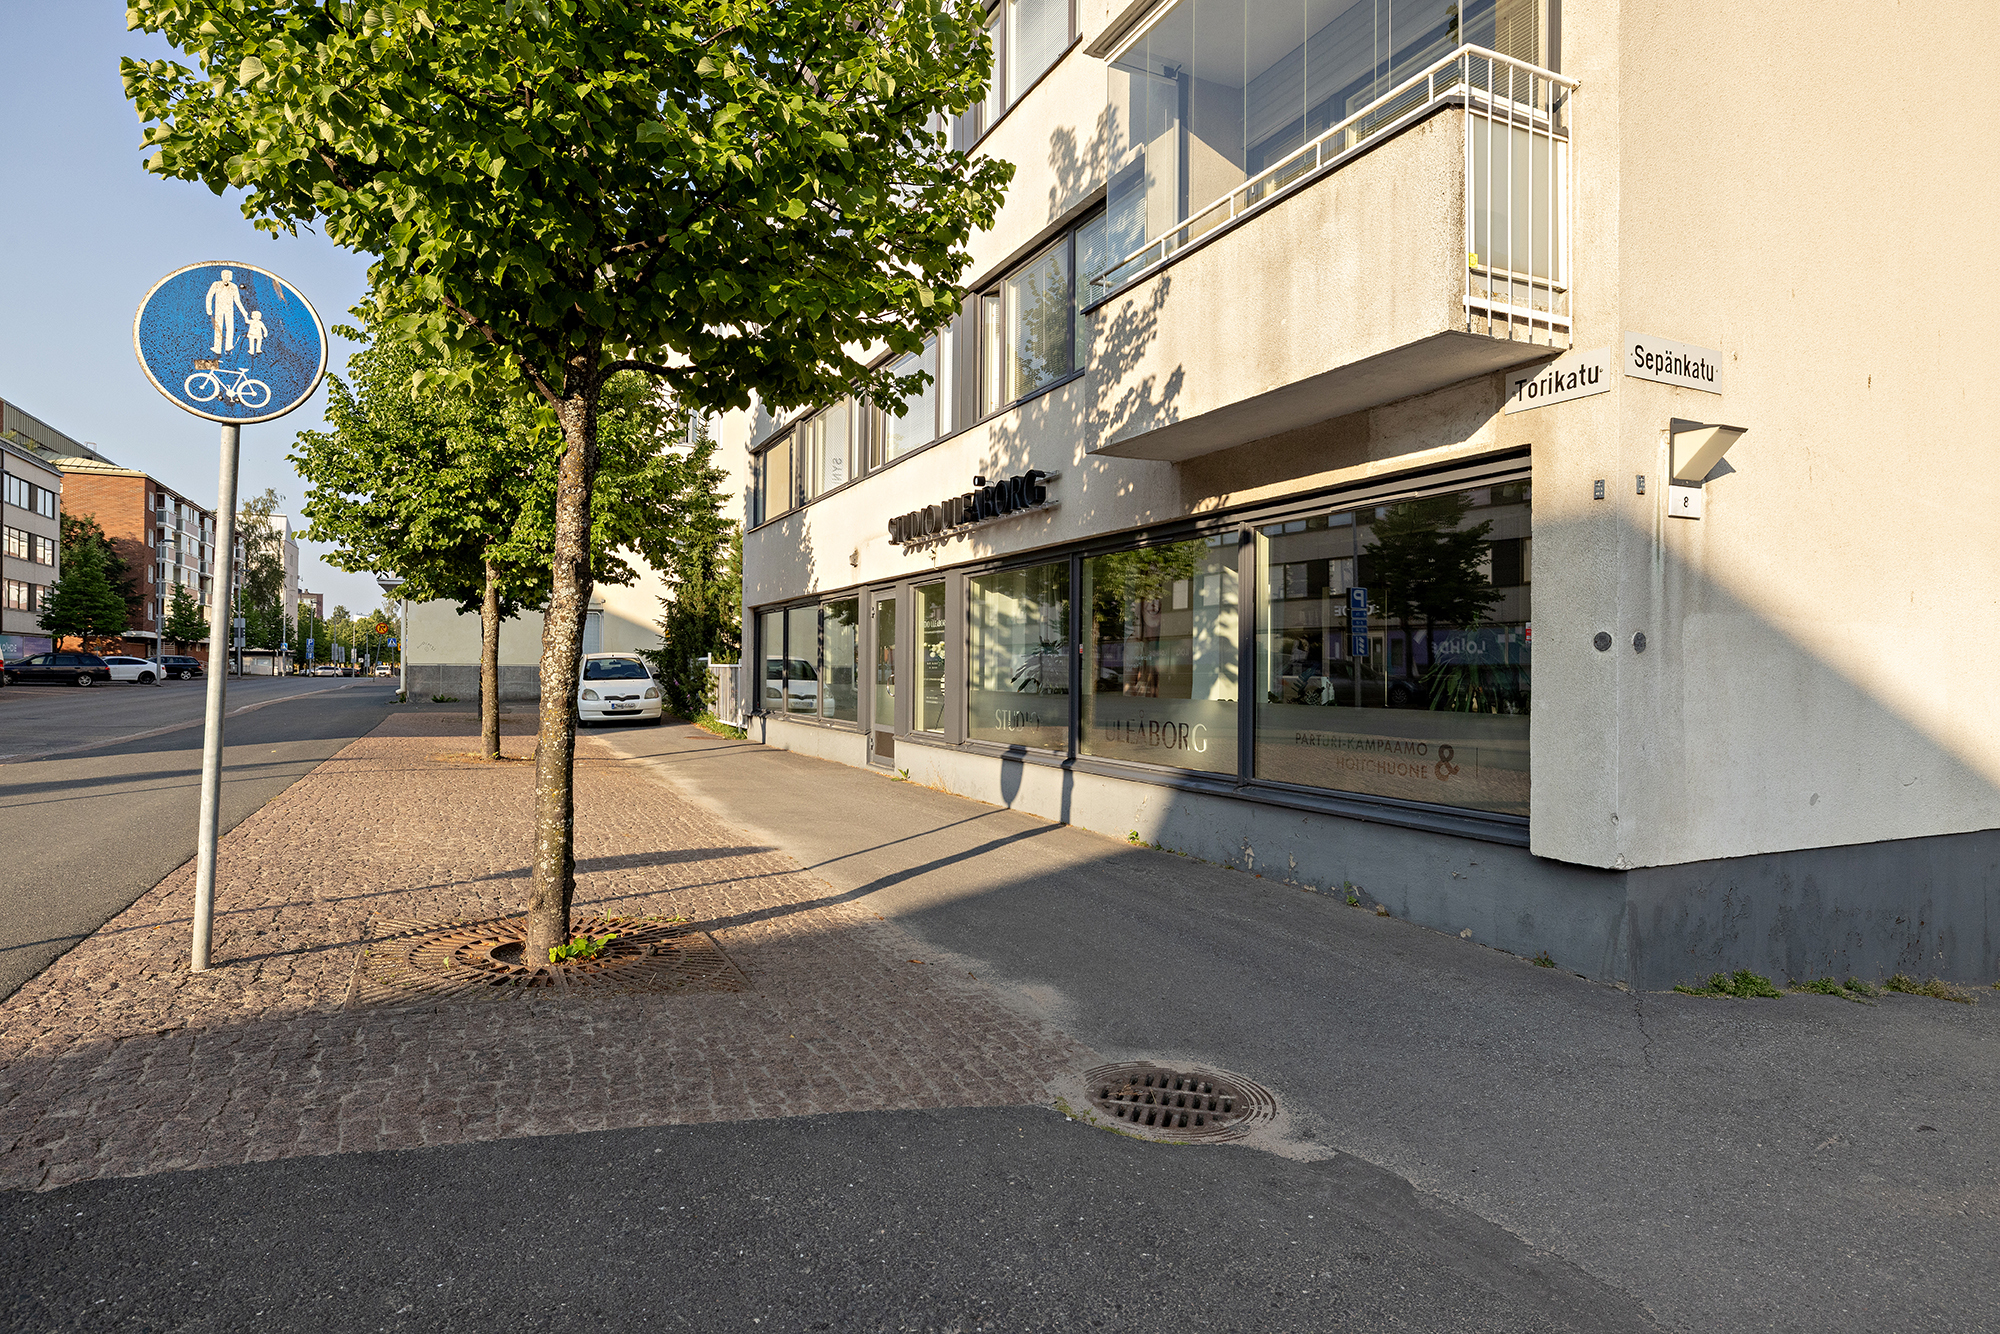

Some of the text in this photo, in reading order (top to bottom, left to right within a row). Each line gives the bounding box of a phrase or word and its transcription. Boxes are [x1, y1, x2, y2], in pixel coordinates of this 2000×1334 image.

[1634, 344, 1715, 382] Sepänkatu
[1514, 363, 1600, 402] Torikatu
[1683, 495, 1690, 508] 8
[1105, 709, 1208, 753] ULEÅBORG
[1295, 732, 1428, 757] PARTURI-KAMPAAMO
[1434, 743, 1460, 782] &
